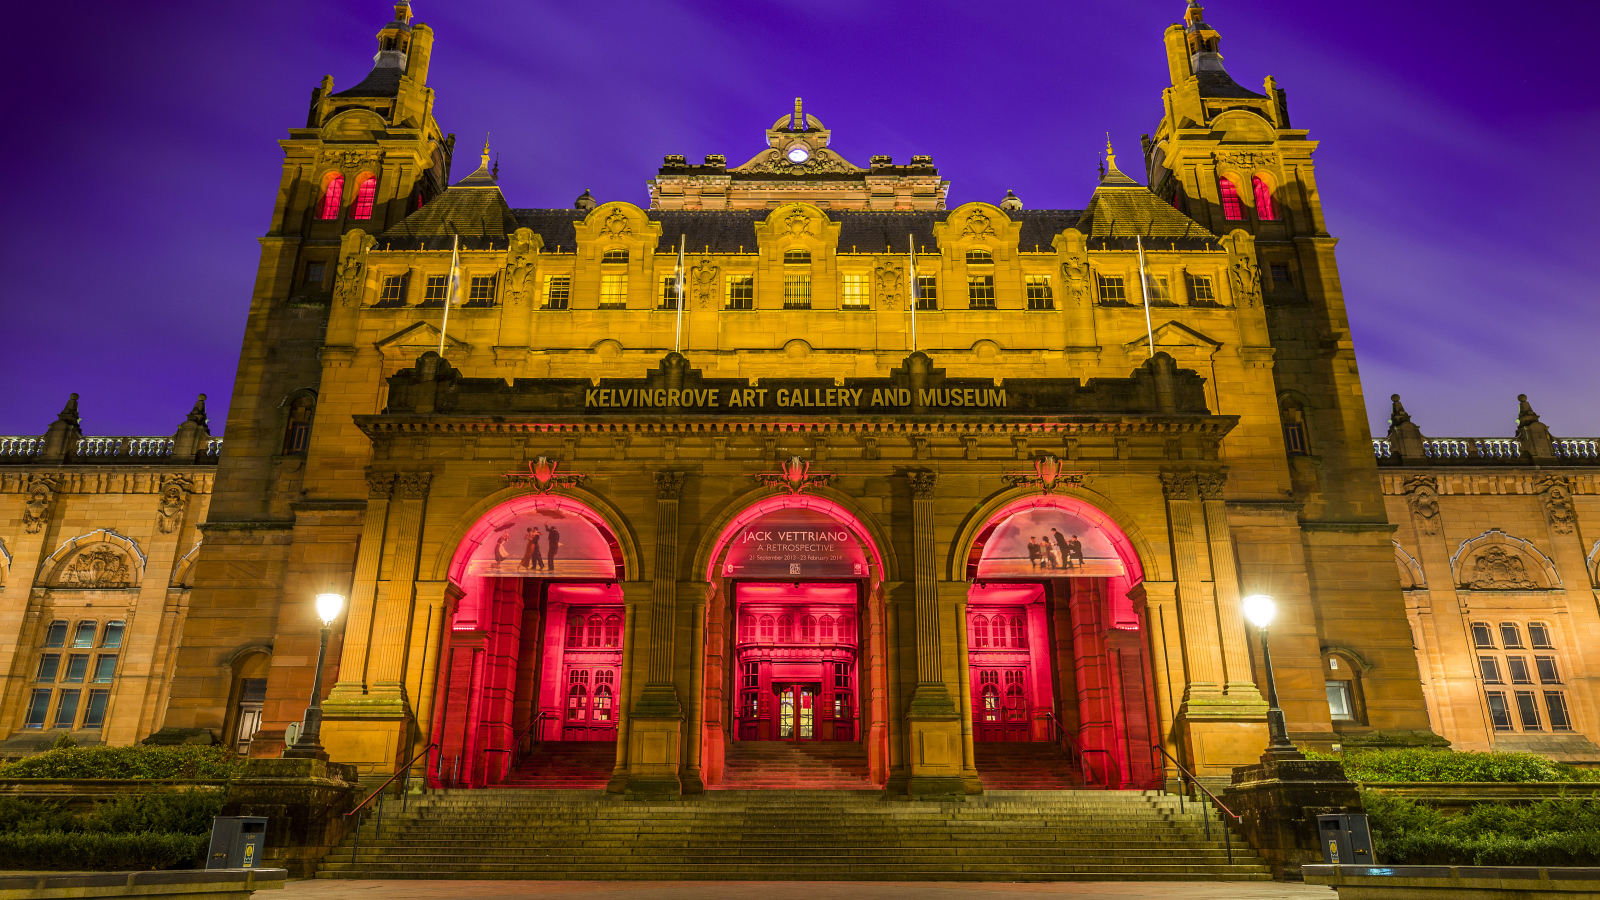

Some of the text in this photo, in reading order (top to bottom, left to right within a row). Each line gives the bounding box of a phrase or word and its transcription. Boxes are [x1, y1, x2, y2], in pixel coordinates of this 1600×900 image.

[585, 389, 1007, 407] KELVINGROVE ART GALLERY AND MUSEUM
[743, 532, 848, 544] JACK VETTRIANO
[766, 544, 834, 552] RETROSPECTIVE
